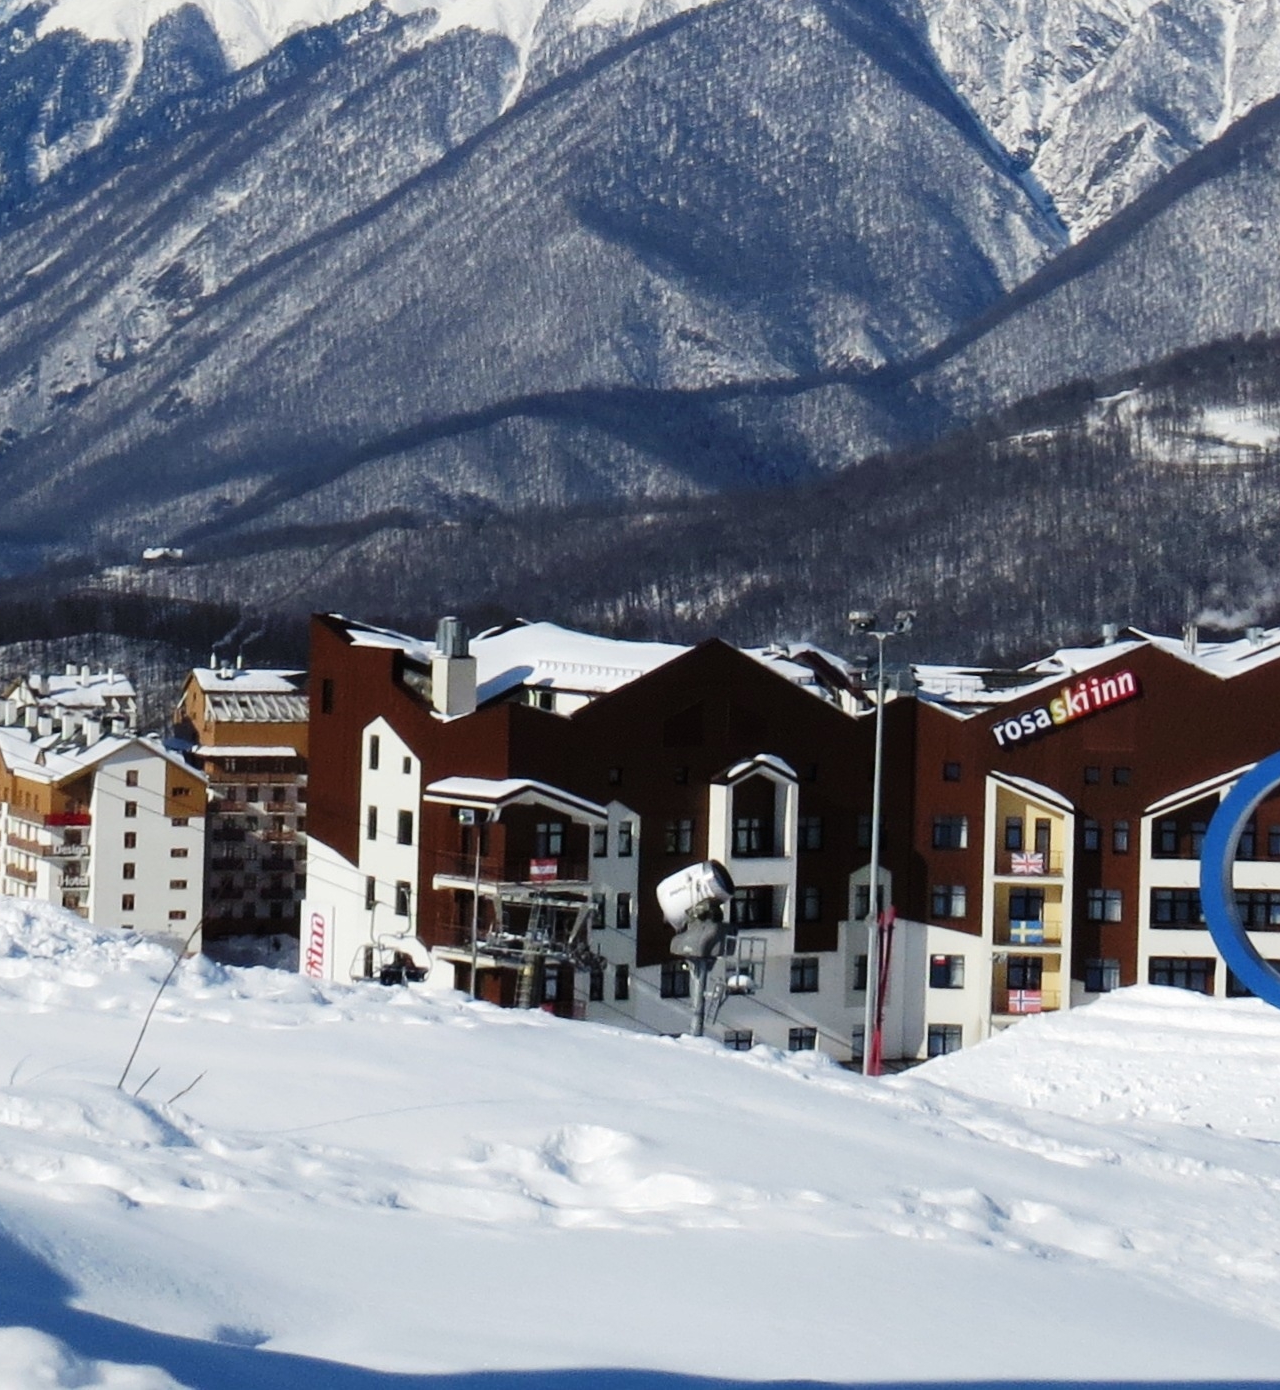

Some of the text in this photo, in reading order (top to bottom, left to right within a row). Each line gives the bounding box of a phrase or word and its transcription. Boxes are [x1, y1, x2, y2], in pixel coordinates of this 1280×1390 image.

[992, 671, 1134, 746] rosa ski inn
[53, 844, 88, 859] Design
[59, 875, 88, 886] Hotel
